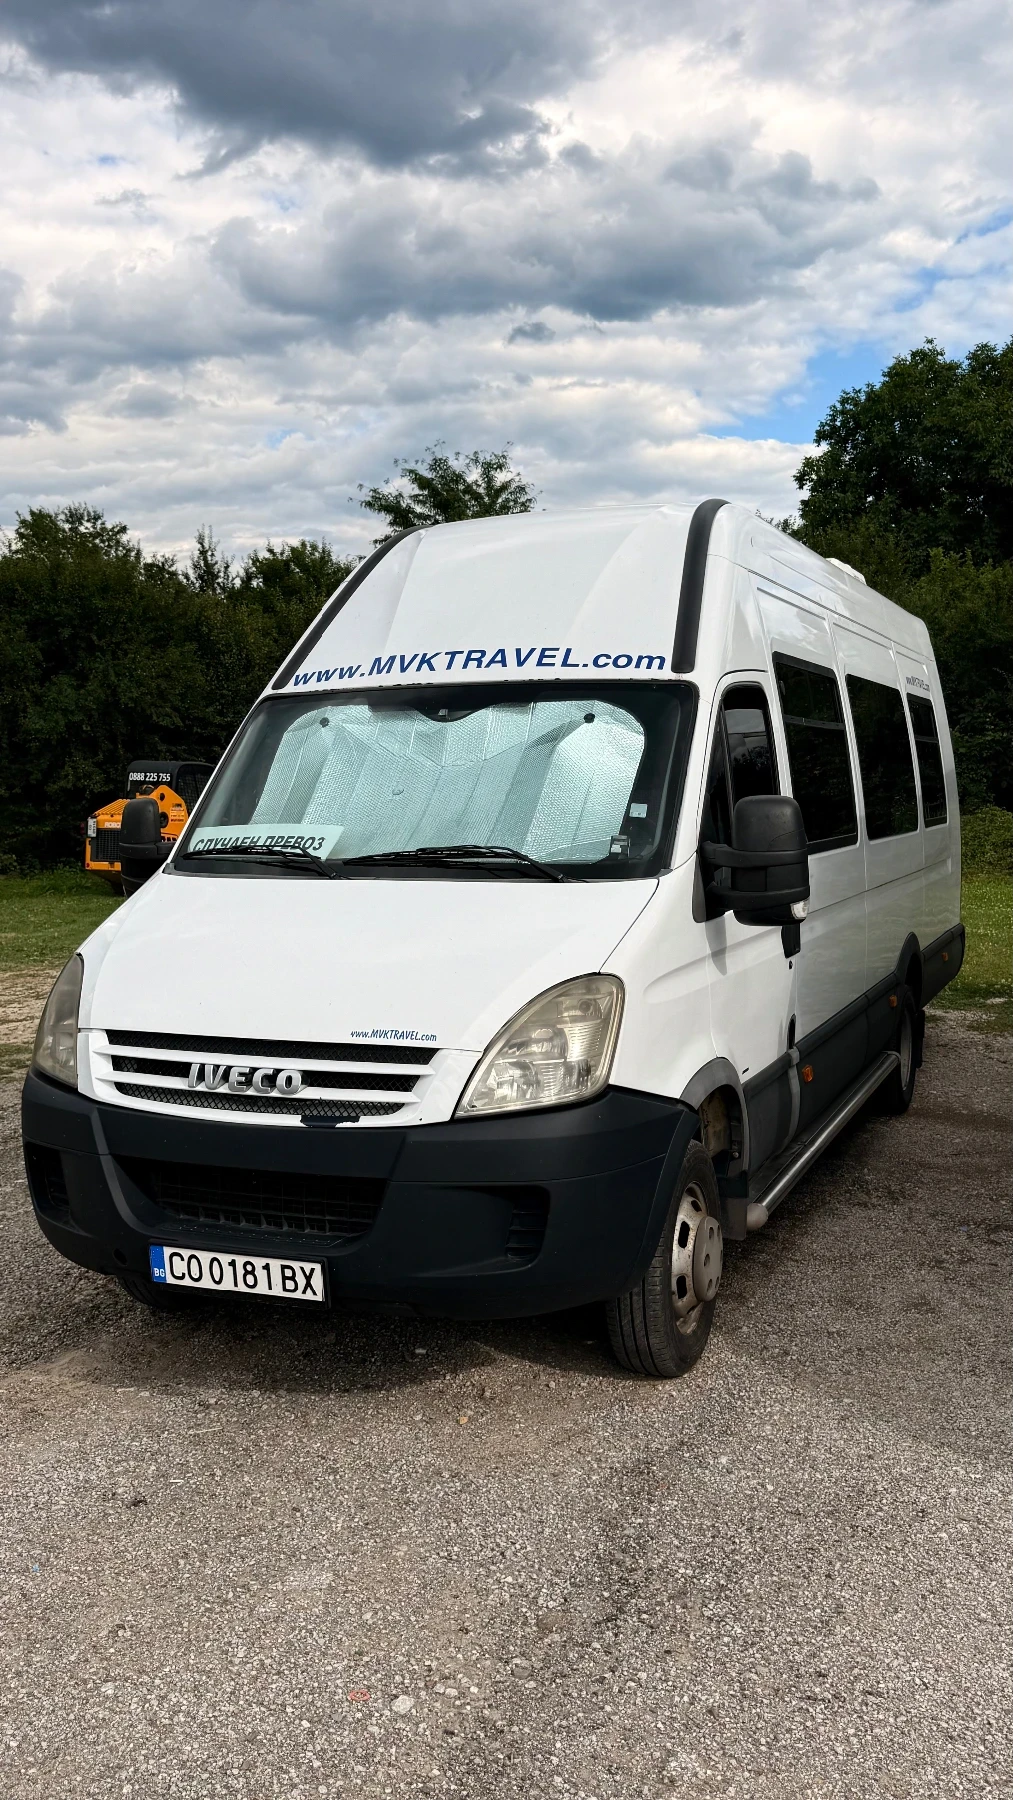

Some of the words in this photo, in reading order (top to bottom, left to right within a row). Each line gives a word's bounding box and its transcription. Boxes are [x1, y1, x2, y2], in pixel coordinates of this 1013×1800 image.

[293, 647, 666, 687] www.MVKTRAVEL.com
[129, 772, 145, 781] 0888
[145, 772, 158, 782] 225
[158, 773, 171, 782] 755
[262, 835, 326, 851] ПРЕВОЗ
[350, 1029, 437, 1042] www.MVKTRAVEL.com
[188, 1063, 306, 1095] IVECO
[154, 1267, 165, 1278] BG
